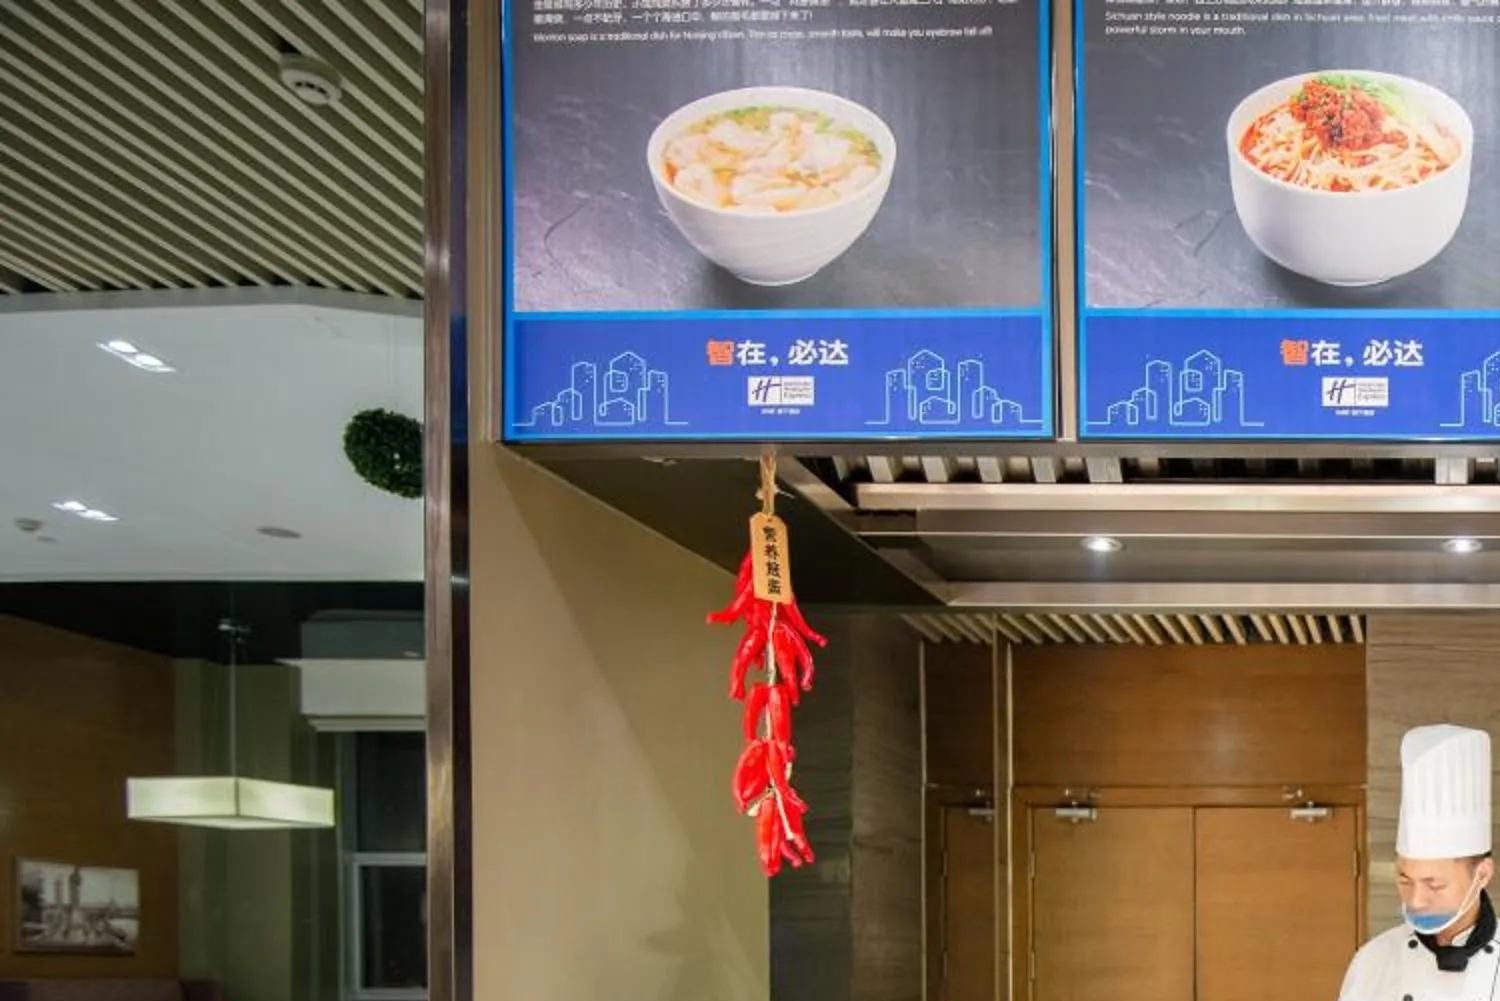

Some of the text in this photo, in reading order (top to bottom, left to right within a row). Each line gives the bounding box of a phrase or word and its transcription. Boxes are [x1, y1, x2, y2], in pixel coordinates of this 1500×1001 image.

[1144, 11, 1166, 22] style
[1168, 11, 1201, 20] noodle
[909, 29, 925, 38] you
[1105, 25, 1148, 36] powerful
[1190, 28, 1211, 37] your
